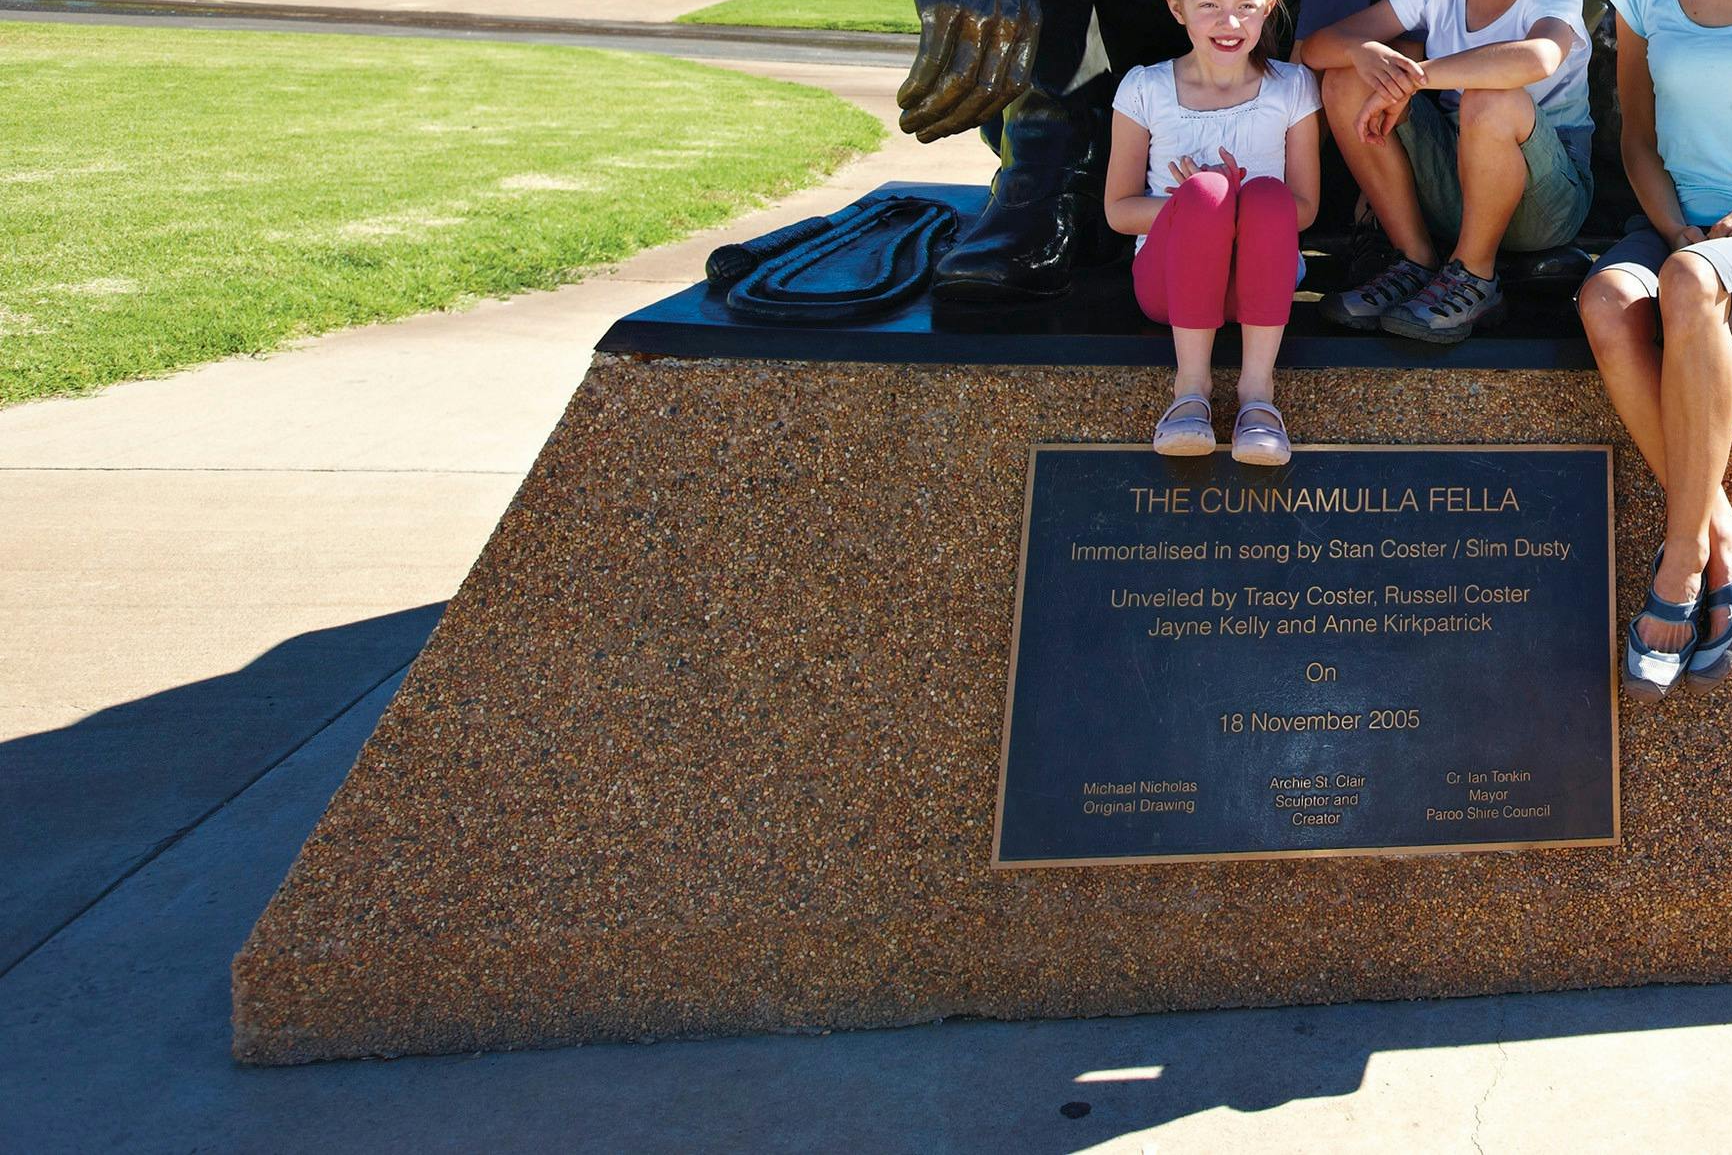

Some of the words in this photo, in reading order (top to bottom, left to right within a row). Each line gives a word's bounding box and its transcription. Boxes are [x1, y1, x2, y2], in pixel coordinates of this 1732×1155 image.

[1130, 488, 1191, 513] THE
[1200, 487, 1419, 513] CUNNAMULLA
[1429, 487, 1520, 512] FELLA
[1071, 540, 1208, 561] Immortalised
[1215, 542, 1232, 560] in
[1238, 545, 1290, 564] song
[1297, 540, 1321, 564] by
[1329, 539, 1374, 560] Stan
[1381, 539, 1447, 559] Coster
[1453, 539, 1460, 560] /
[1466, 538, 1508, 558] Slim
[1515, 538, 1571, 560] Dusty
[1111, 588, 1204, 608] Unveiled
[1211, 589, 1237, 611] by
[1243, 587, 1300, 610] Tracy
[1307, 586, 1379, 608] Coster,
[1384, 585, 1457, 604] Russell
[1464, 585, 1530, 604] Coster
[1148, 616, 1212, 640] Jayne
[1220, 616, 1270, 638] Kelly
[1277, 616, 1316, 633] and
[1323, 615, 1377, 633] Anne
[1384, 613, 1493, 635] Kirkpatrick
[1306, 663, 1336, 682] On
[1220, 714, 1244, 733] 18
[1252, 712, 1361, 733] November
[1369, 710, 1420, 730] 2005
[1270, 775, 1312, 790] Archie
[1315, 775, 1332, 789] St.
[1336, 774, 1366, 788] Clair
[1468, 771, 1488, 784] Ian
[1491, 770, 1531, 783] Tonkin
[1083, 781, 1137, 795] Michael
[1140, 778, 1199, 794] Nicholas
[1275, 794, 1330, 810] Sculptor
[1333, 794, 1359, 806] and
[1469, 789, 1508, 804] Mayor
[1083, 799, 1136, 816] Original
[1140, 798, 1195, 814] Drawing
[1426, 808, 1464, 821] Paroo
[1467, 806, 1499, 820] Shire
[1502, 804, 1551, 818] Council
[1292, 812, 1341, 826] Creator
